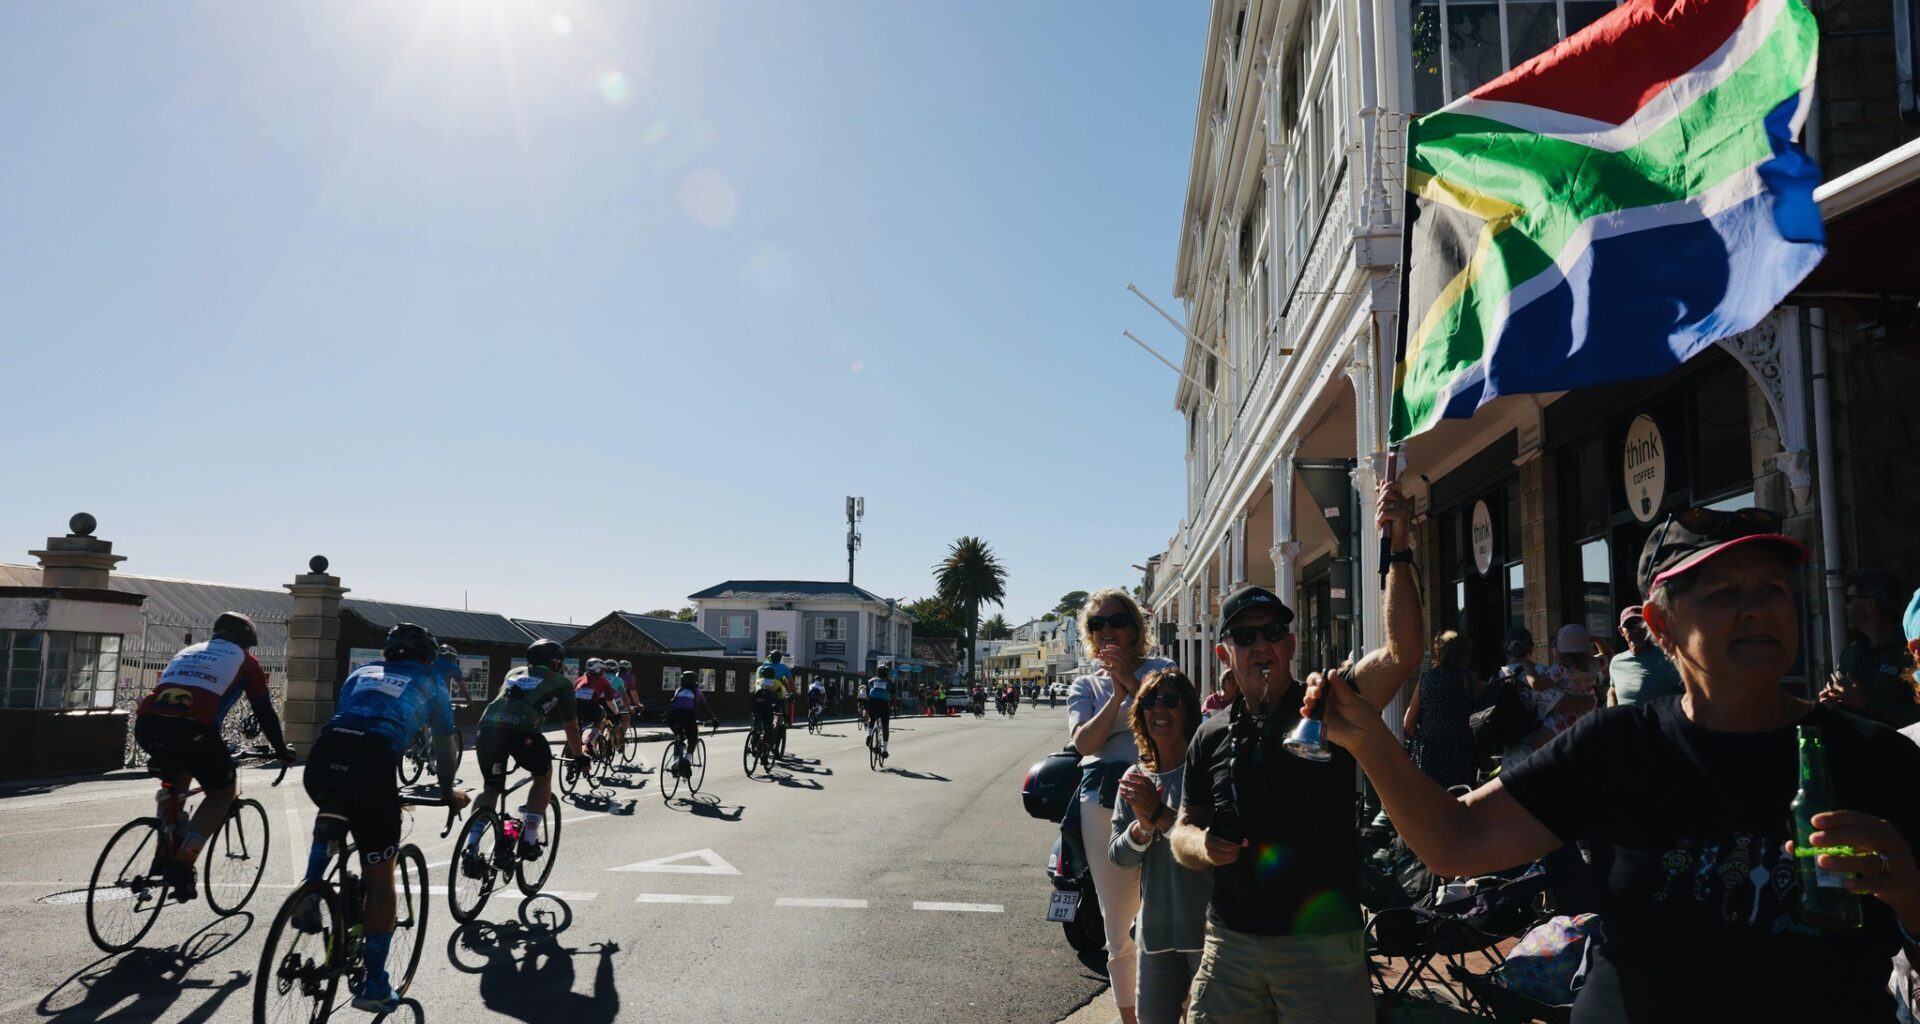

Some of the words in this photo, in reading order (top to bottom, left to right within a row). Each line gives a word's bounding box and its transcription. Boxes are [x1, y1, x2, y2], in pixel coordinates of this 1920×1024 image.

[1626, 431, 1659, 469] think
[1632, 466, 1656, 485] COFFEE
[1473, 519, 1491, 544] think
[176, 670, 218, 683] MOTORS
[1052, 894, 1062, 904] CA
